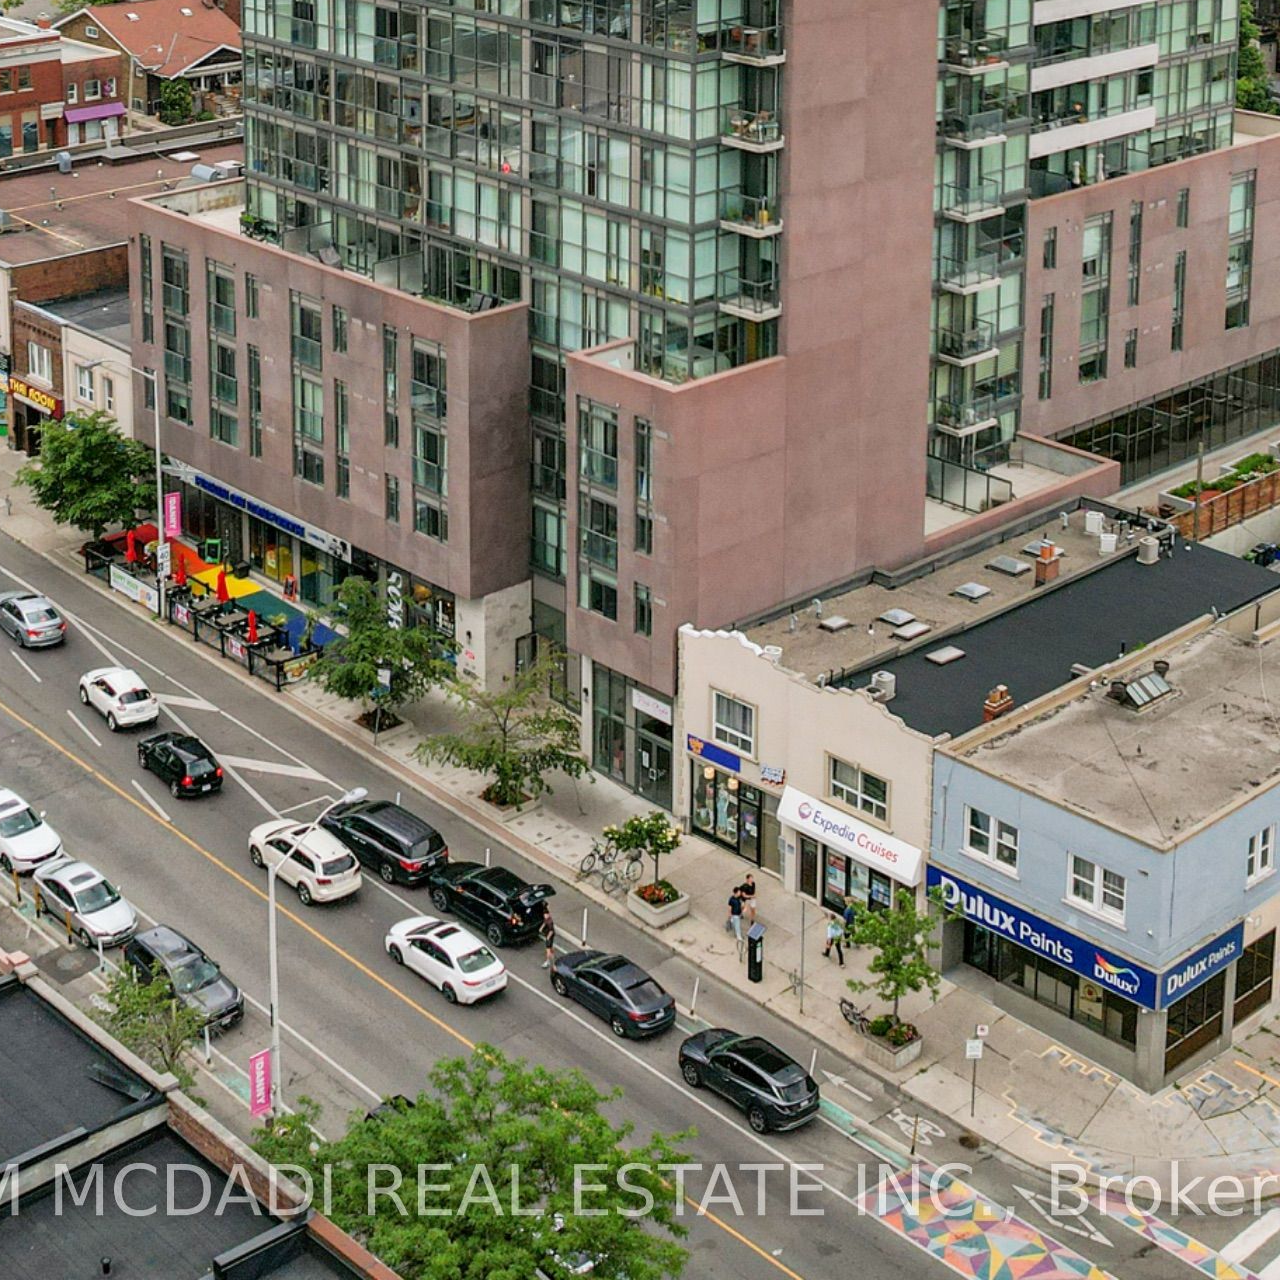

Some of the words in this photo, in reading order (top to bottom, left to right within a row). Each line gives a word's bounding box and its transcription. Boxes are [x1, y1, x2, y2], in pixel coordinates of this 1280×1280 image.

[28, 387, 56, 410] ROOM
[813, 810, 856, 842] Expedia
[857, 832, 899, 863] Cruises
[941, 875, 1016, 936] Dulux
[1020, 921, 1074, 964] Paints
[1094, 964, 1134, 995] Dulux
[1167, 957, 1208, 995] Dulux
[1208, 941, 1235, 968] Paints
